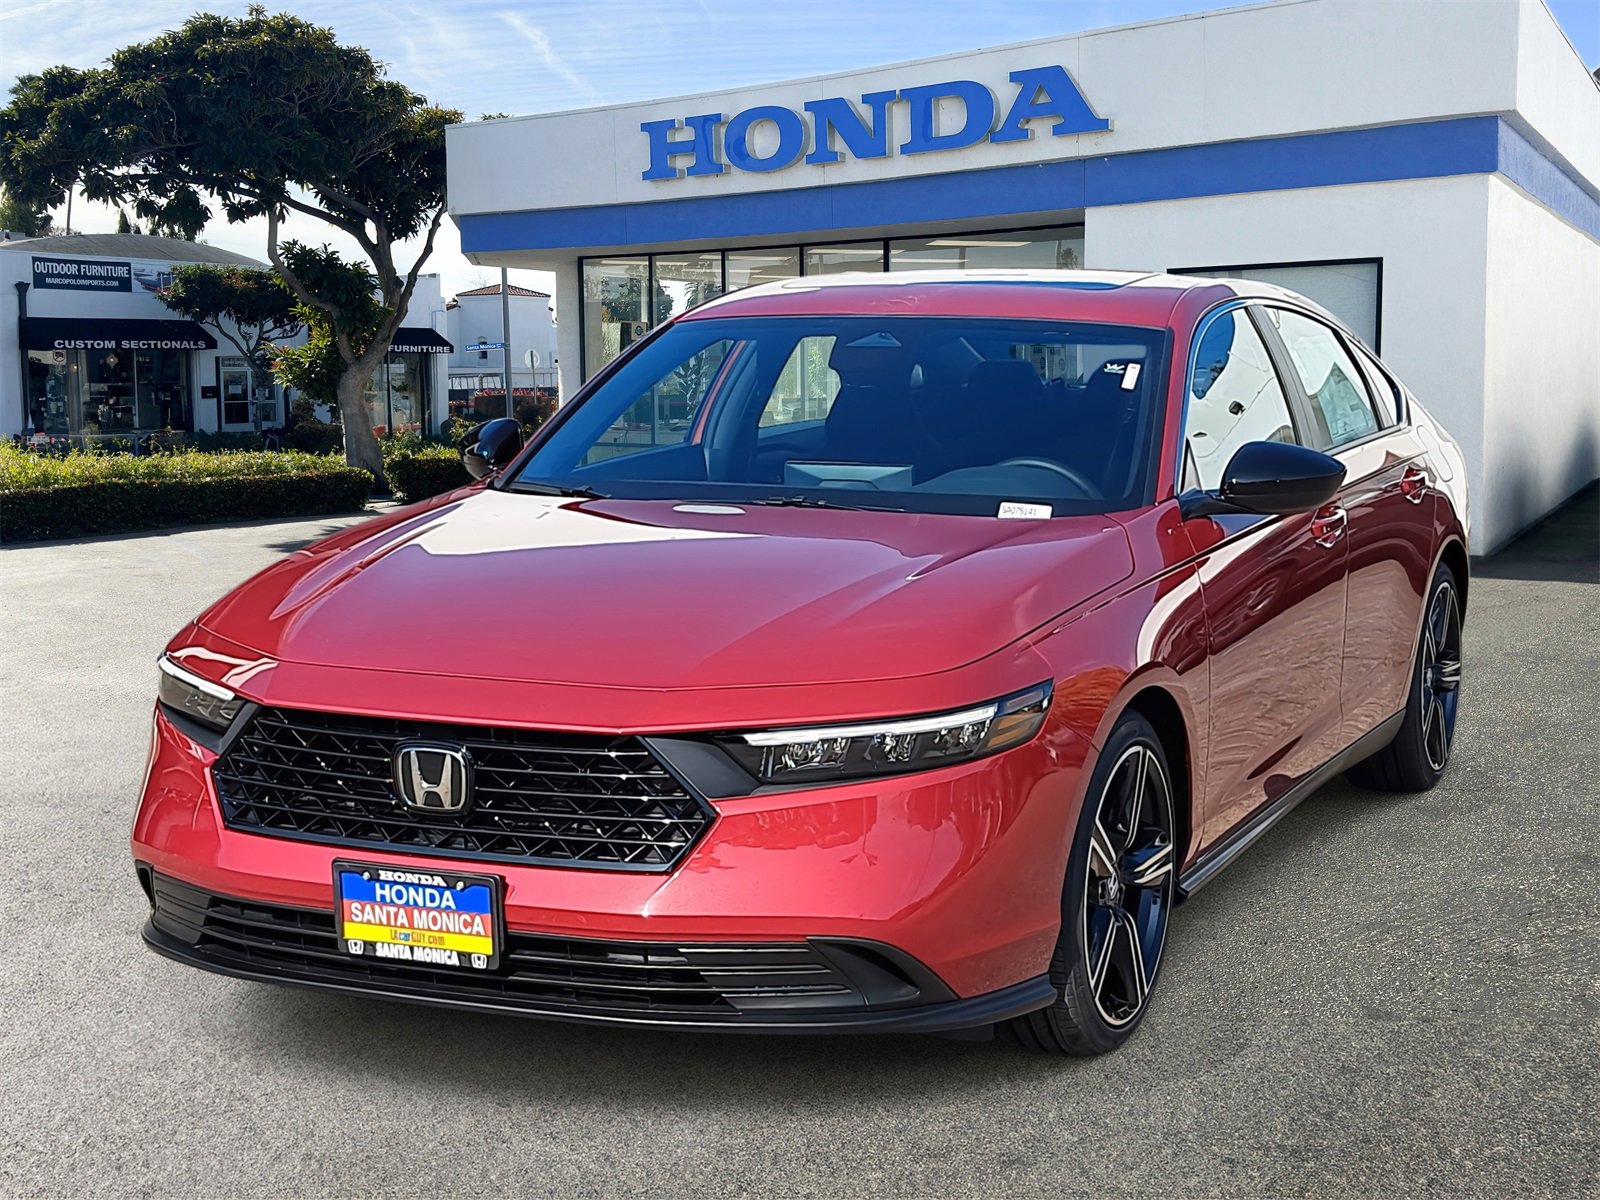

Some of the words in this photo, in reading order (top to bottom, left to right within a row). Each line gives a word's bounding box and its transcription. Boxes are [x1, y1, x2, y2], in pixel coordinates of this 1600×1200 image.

[640, 64, 1114, 182] HONDA
[34, 261, 78, 275] OUTDOOR
[80, 264, 130, 278] FURNITURE
[45, 277, 119, 287] MARCOPOLOIMPORTS.COM
[54, 339, 116, 349] CUSTOM
[121, 340, 206, 349] SECTIONALS
[388, 344, 450, 353] FURNITURE
[378, 870, 447, 887] HONDA
[375, 883, 456, 910] HONDA
[351, 902, 409, 928] SANTA
[412, 909, 486, 936] MONICA
[375, 942, 412, 961] SANTA
[413, 945, 460, 966] MONICA
